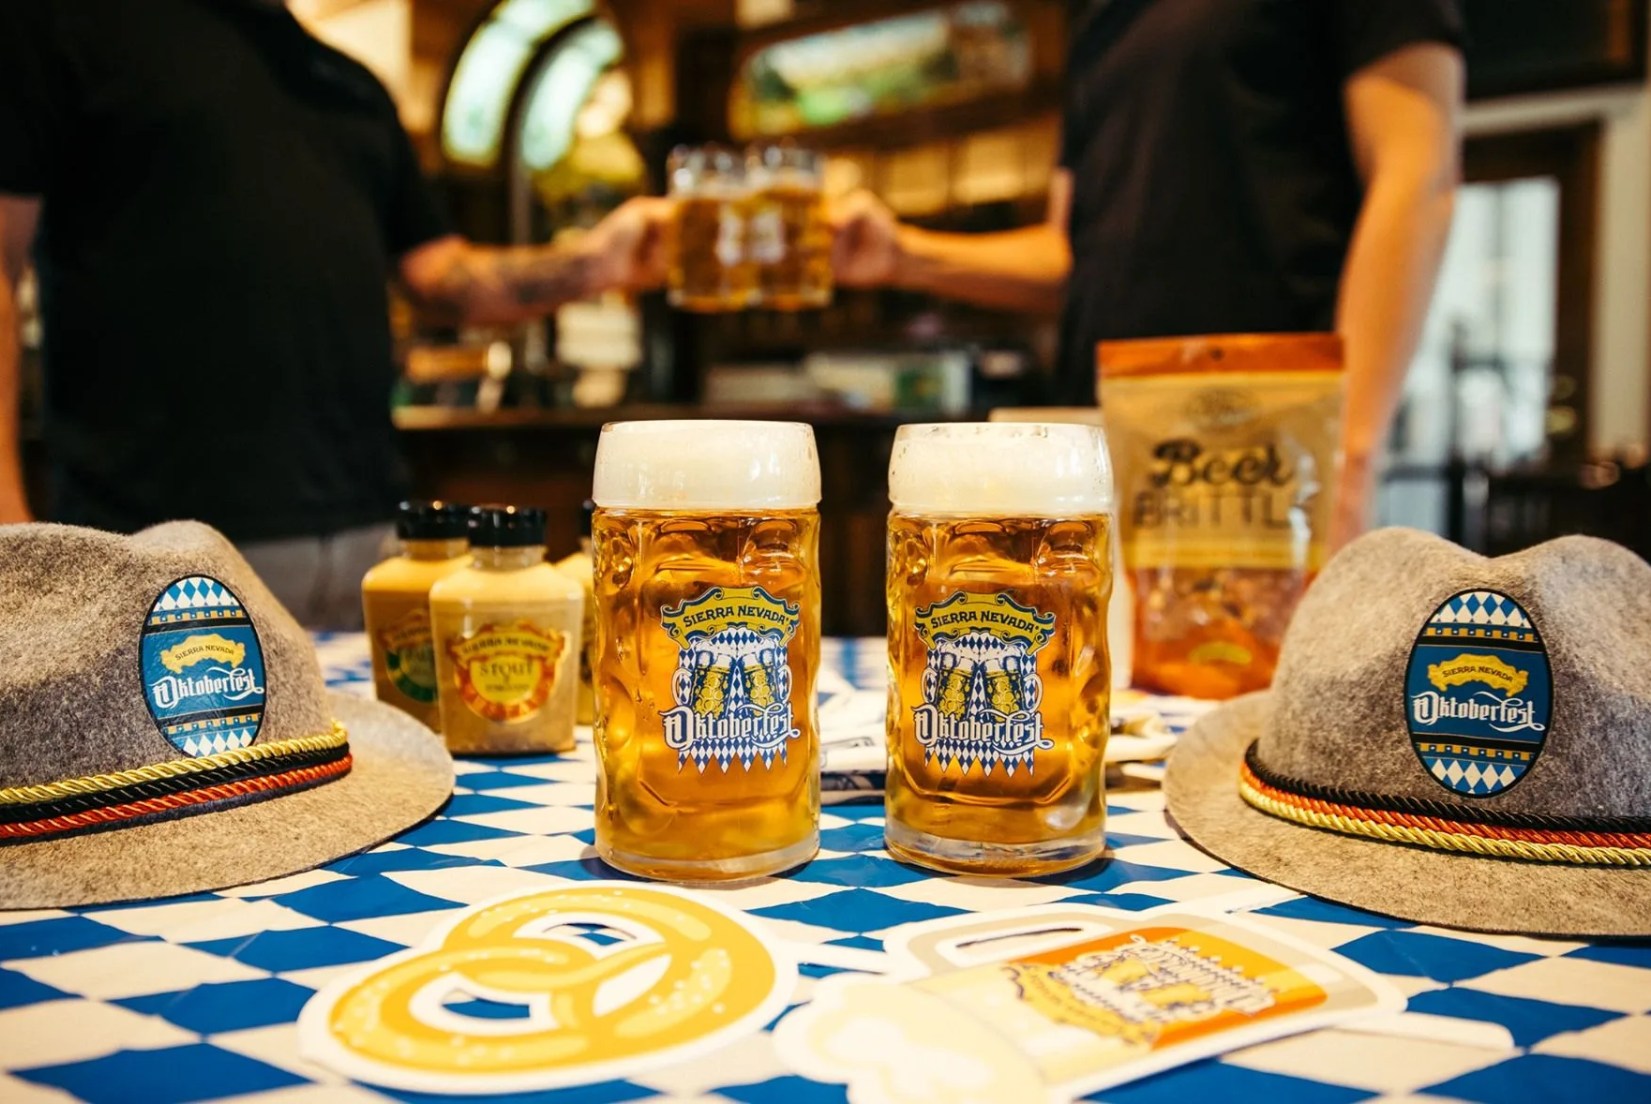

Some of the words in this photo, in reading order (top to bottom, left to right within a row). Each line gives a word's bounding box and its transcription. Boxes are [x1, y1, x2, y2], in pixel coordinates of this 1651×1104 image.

[1148, 437, 1294, 488] Beer
[1132, 489, 1310, 530] BRITTL
[683, 606, 734, 628] SIERRA
[931, 610, 977, 629] SIERRA
[175, 645, 205, 661] SIERRA
[205, 644, 235, 656] NEVADA
[149, 666, 265, 709] Oktoberfest
[1442, 665, 1476, 678] SIERRA
[1478, 665, 1514, 683] NEVADA
[659, 702, 801, 750] Oktoberfest
[911, 703, 1055, 755] Oktoberfest
[1411, 690, 1546, 733] Oktoberfest
